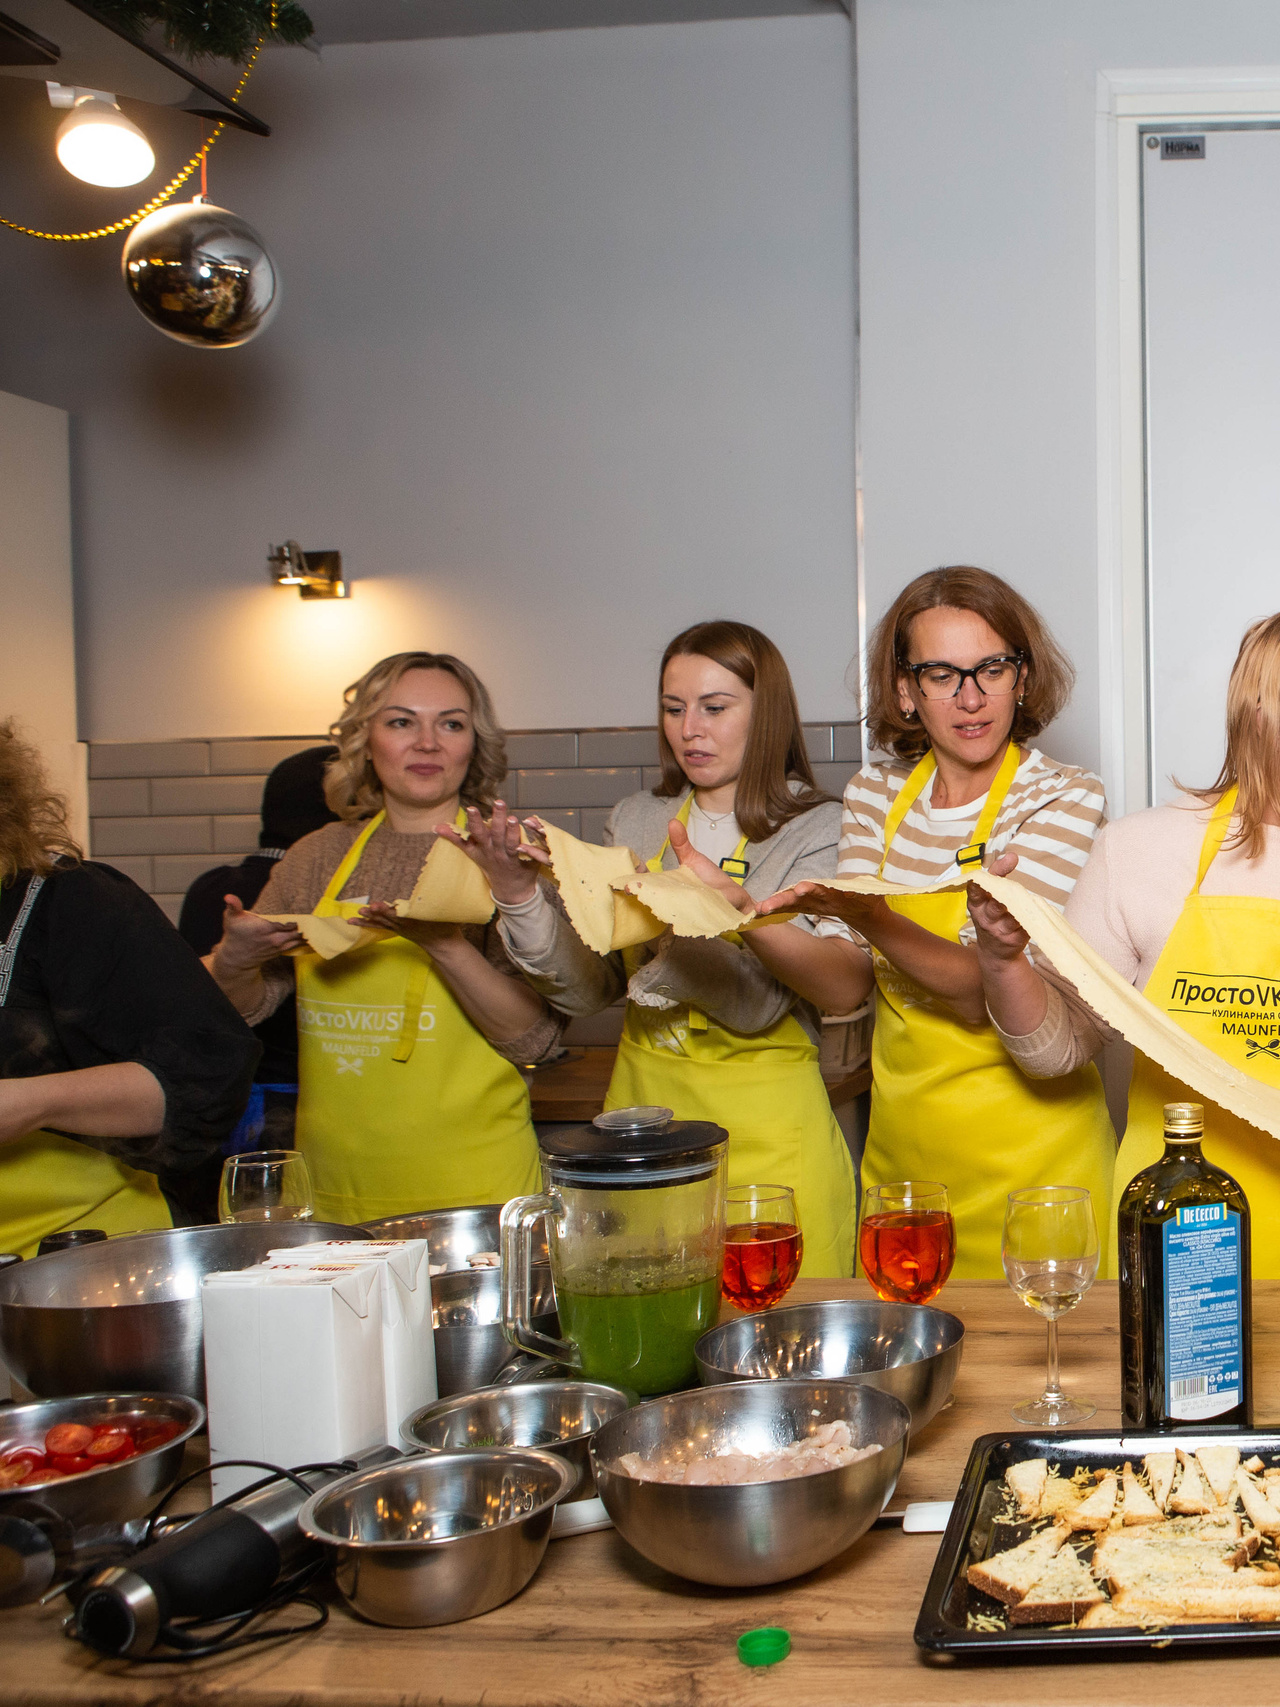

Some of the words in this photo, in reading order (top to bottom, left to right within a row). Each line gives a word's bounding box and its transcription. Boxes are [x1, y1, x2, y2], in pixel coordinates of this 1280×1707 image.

[1212, 1009, 1275, 1020] КУЛИНАРНАЯ
[322, 1042, 381, 1057] MAUNFELD
[1195, 1206, 1220, 1222] CECCO
